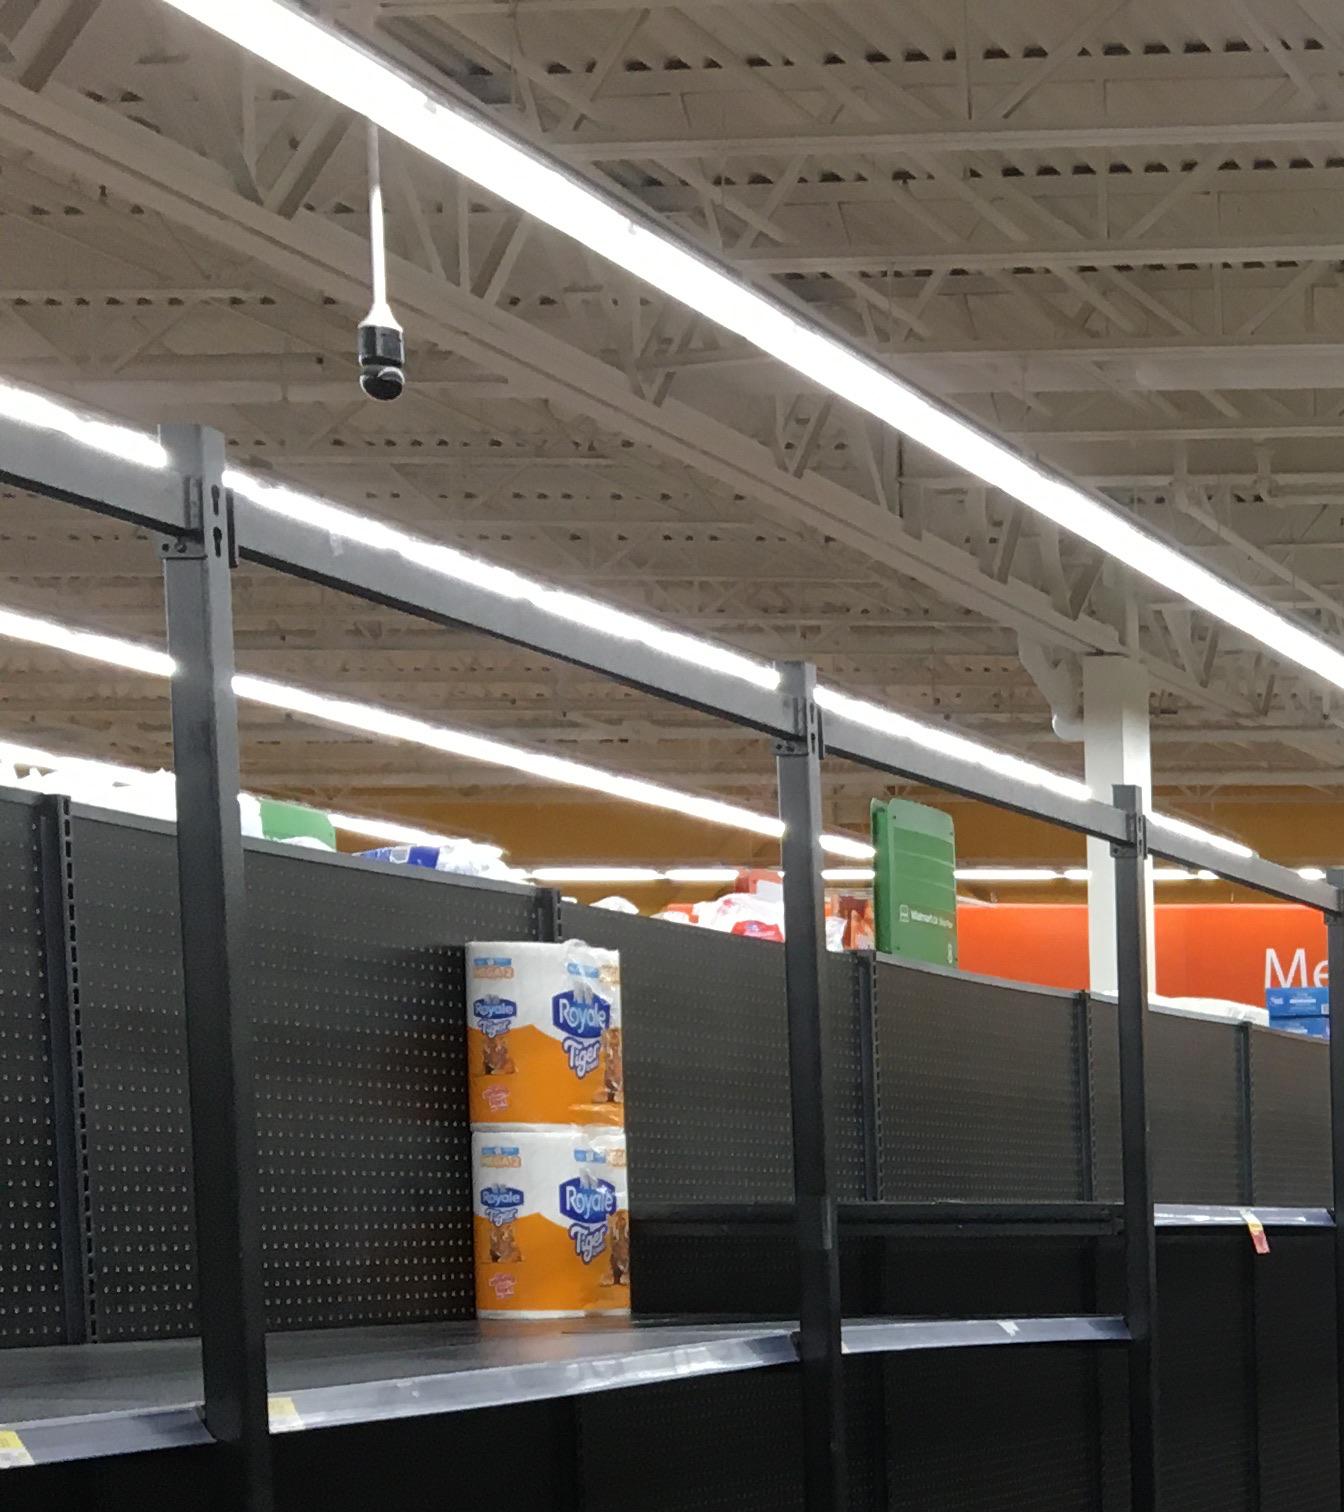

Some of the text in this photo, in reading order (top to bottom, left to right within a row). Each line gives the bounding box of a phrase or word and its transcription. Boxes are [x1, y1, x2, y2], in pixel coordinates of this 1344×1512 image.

[475, 1001, 514, 1018] Royale
[559, 998, 607, 1033] Royale
[563, 1037, 600, 1078] Tiger
[482, 1190, 520, 1206] Royale
[566, 1185, 613, 1219] Royale
[569, 1223, 608, 1264] Tiger
